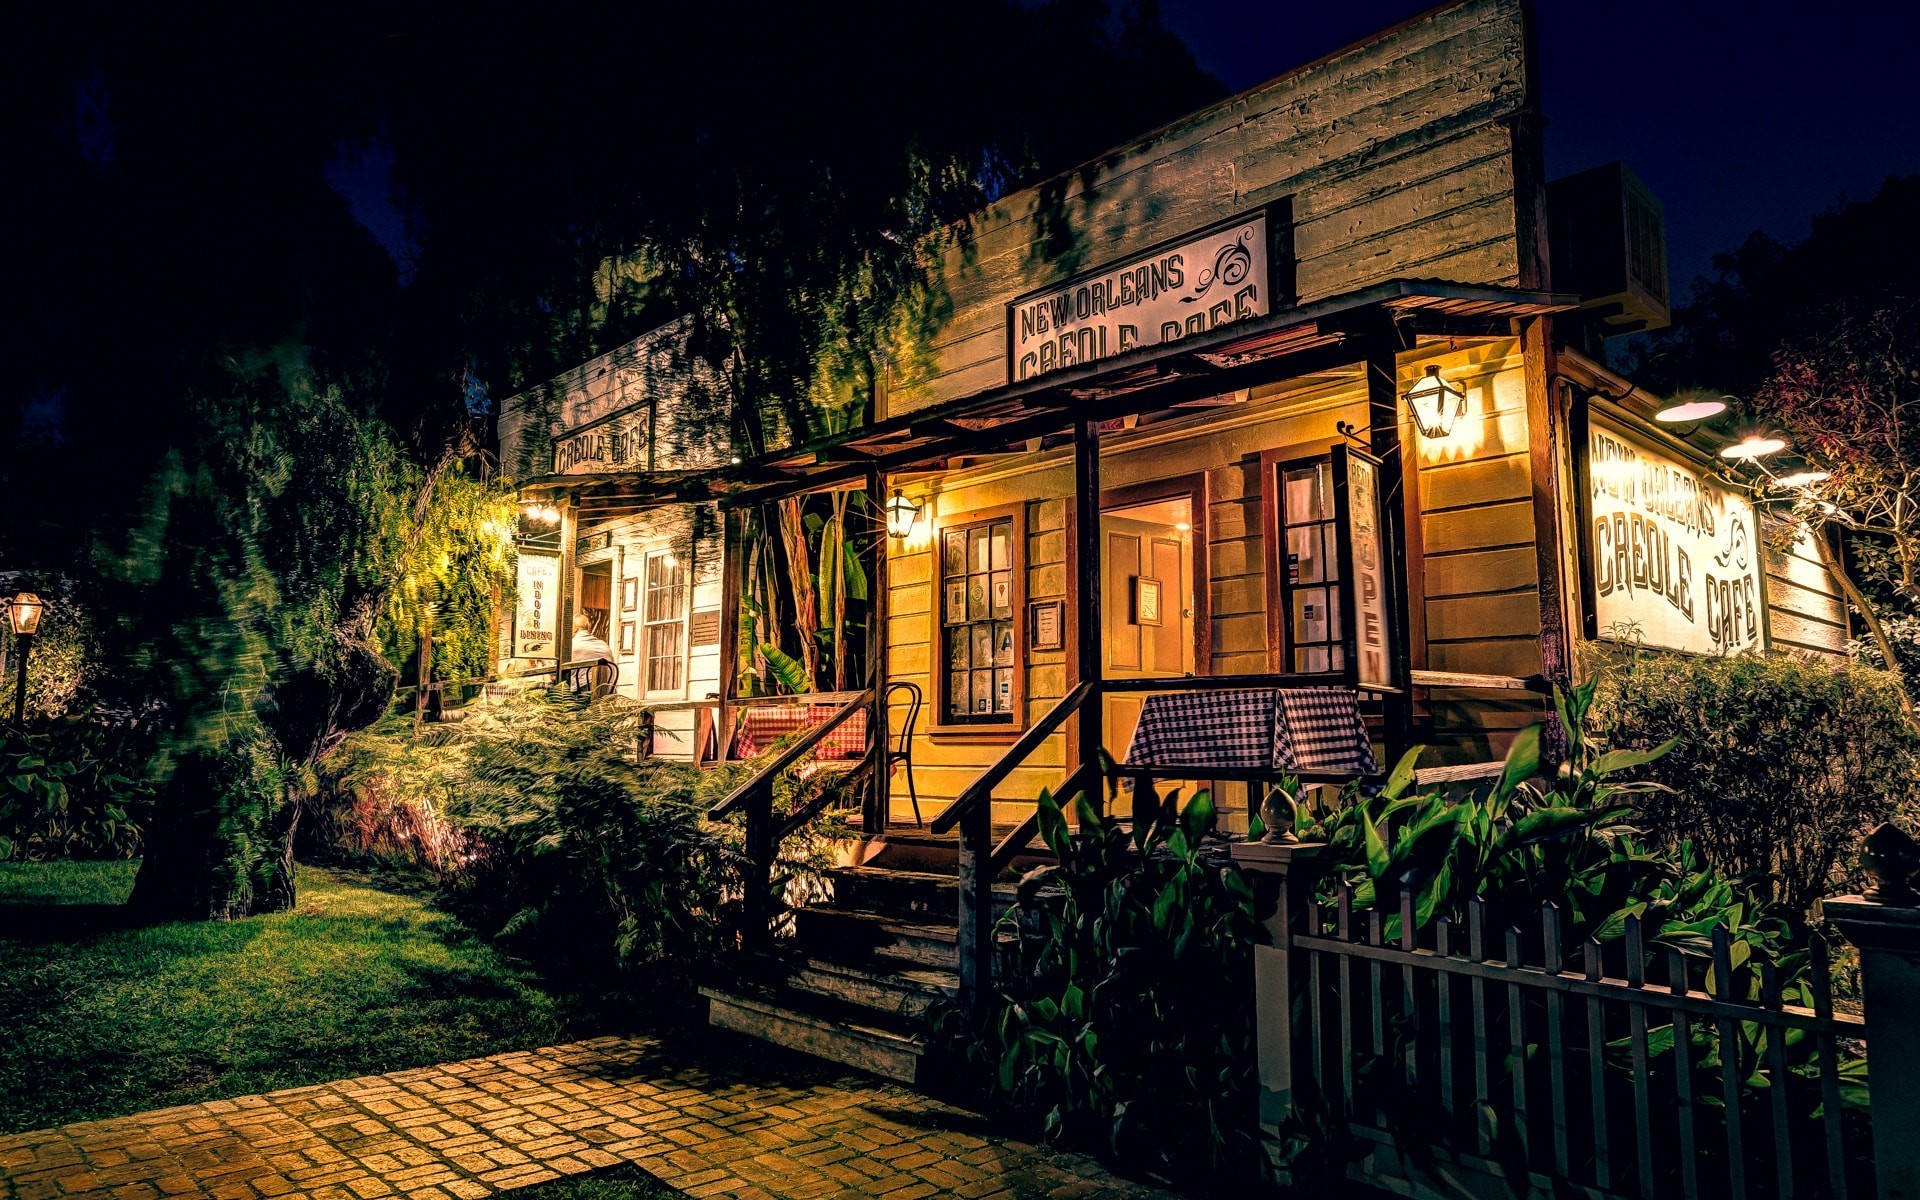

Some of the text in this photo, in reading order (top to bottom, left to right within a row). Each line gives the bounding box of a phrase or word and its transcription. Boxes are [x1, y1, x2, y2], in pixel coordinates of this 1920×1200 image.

[1020, 254, 1185, 344] NEW ORLEANS
[559, 418, 648, 474] CREOLE CAFE
[1642, 464, 1715, 540] ORLEANS
[1594, 511, 1694, 624] CREOLE
[1706, 573, 1757, 651] CAFE
